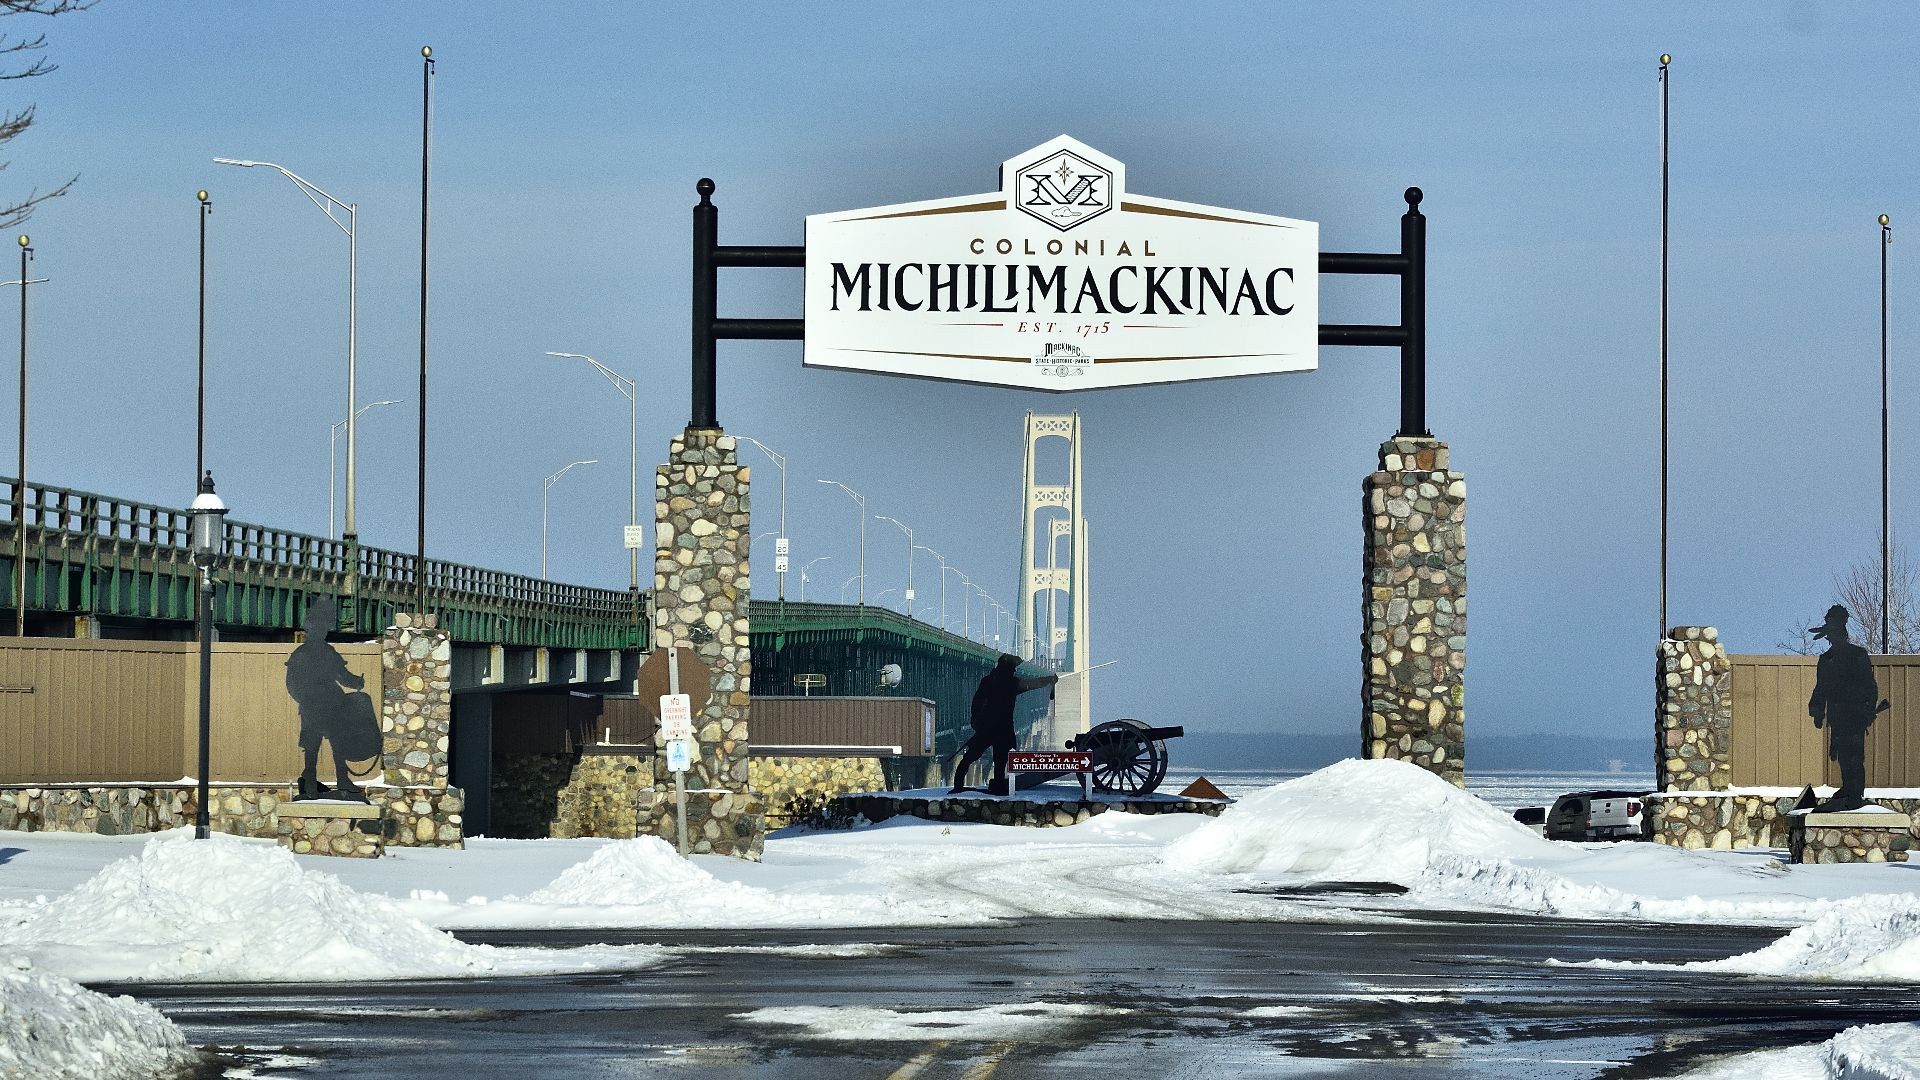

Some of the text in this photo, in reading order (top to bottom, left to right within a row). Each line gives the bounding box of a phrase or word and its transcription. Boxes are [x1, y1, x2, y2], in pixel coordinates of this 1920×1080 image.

[969, 238, 1156, 257] COLONIAL
[829, 262, 1295, 316] MICHILIMACKINAC
[1017, 321, 1110, 338] EST. 1715
[670, 698, 680, 706] NO
